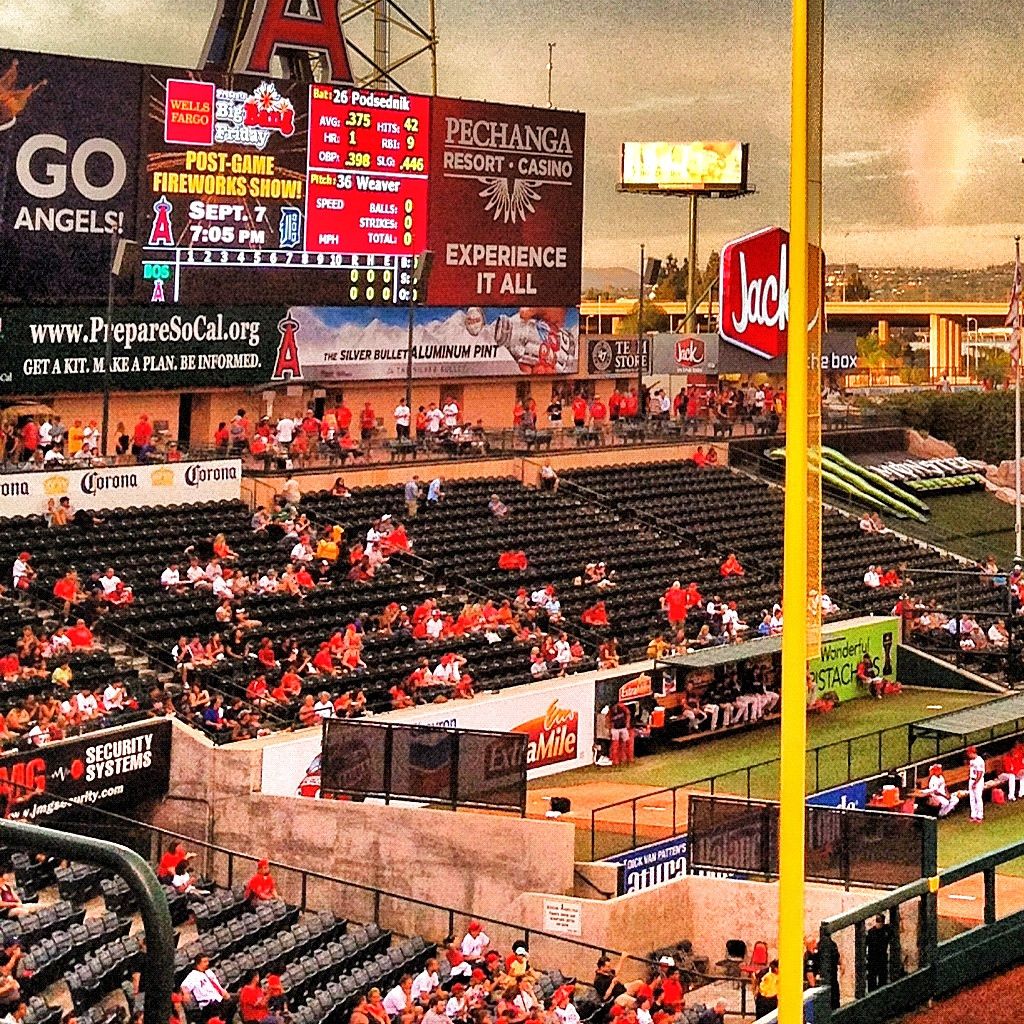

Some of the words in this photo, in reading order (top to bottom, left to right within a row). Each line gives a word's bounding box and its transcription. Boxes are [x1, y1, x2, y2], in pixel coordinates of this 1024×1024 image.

[170, 100, 210, 112] WELLS
[313, 88, 332, 100] Bat:
[333, 89, 348, 104] 26
[351, 91, 410, 110] Podsednik
[171, 112, 209, 125] FARGO
[320, 116, 340, 127] AVG:
[346, 112, 370, 127] .375
[377, 122, 400, 133] HITS:
[404, 118, 418, 132] 42
[216, 123, 270, 150] Friday
[324, 132, 340, 143] HR:
[349, 130, 356, 144] 1
[382, 138, 400, 149] RBI:
[407, 136, 415, 149] 9
[445, 117, 573, 154] PECHANGA
[16, 134, 126, 201] GO
[185, 150, 275, 176] POST-GAME
[319, 151, 339, 162] OBP:
[345, 152, 370, 167] .398
[377, 156, 395, 167] SLG:
[400, 157, 424, 171] .446
[444, 151, 505, 172] RESORT
[518, 158, 573, 178] CASINO
[153, 172, 247, 196] FIREWORKS
[250, 177, 302, 199] SHOW!
[311, 174, 336, 185] Pitch:
[337, 175, 352, 188] 36
[356, 176, 400, 191] Weaver
[188, 200, 248, 222] SEPT.
[254, 206, 267, 222] 7
[316, 198, 344, 209] SPEED
[370, 203, 397, 213] BALLS:
[405, 199, 412, 213] 0
[14, 206, 124, 234] ANGELS!
[360, 218, 397, 229] STRIKES:
[404, 215, 412, 229] 0
[189, 225, 235, 243] 7:05
[238, 229, 266, 244] PM
[319, 234, 339, 244] MPH
[368, 233, 397, 244] TOTAL:
[404, 232, 412, 246] 0
[187, 251, 194, 263] 1
[204, 251, 212, 263] 2
[220, 251, 229, 263] 3
[237, 252, 245, 264] 4
[254, 252, 262, 264] 5
[269, 252, 278, 264] 6
[285, 252, 293, 264] 7
[301, 253, 309, 265] 8
[317, 254, 325, 265] 9
[330, 255, 342, 266] 10
[351, 255, 359, 267] R
[367, 255, 375, 267] H
[384, 255, 391, 267] E
[446, 243, 567, 267] EXPERIENCE
[350, 268, 359, 283] 0
[366, 269, 375, 283] 0
[383, 269, 392, 283] 0
[477, 272, 496, 294] IT
[500, 273, 537, 295] ALL
[349, 286, 358, 301] 0
[366, 286, 375, 301] 0
[382, 286, 391, 301] 0
[30, 314, 260, 349] www.PrepareSoCal.org
[324, 352, 337, 361] THE
[340, 349, 372, 361] SILVER
[374, 348, 408, 360] BULLET
[410, 344, 471, 360] ALUMINUM
[473, 344, 500, 359] PINT
[615, 341, 647, 354] TEM
[678, 341, 704, 362] Jack
[23, 358, 50, 375] GET
[51, 359, 61, 374] A
[64, 358, 89, 374] KIT.
[131, 357, 140, 372] A
[143, 356, 177, 372] PLAN.
[180, 355, 194, 371] BE
[199, 353, 261, 369] INFORMED.
[831, 352, 858, 369] box
[80, 471, 138, 496] Corona
[184, 464, 237, 488] Corona
[0, 481, 29, 496] ona
[821, 636, 869, 662] Wonderful
[810, 657, 880, 691] PISTACHS
[85, 733, 153, 764] SECURITY
[85, 750, 153, 782] SYSTEMS
[628, 858, 643, 870] DICK
[644, 851, 657, 864] VAN
